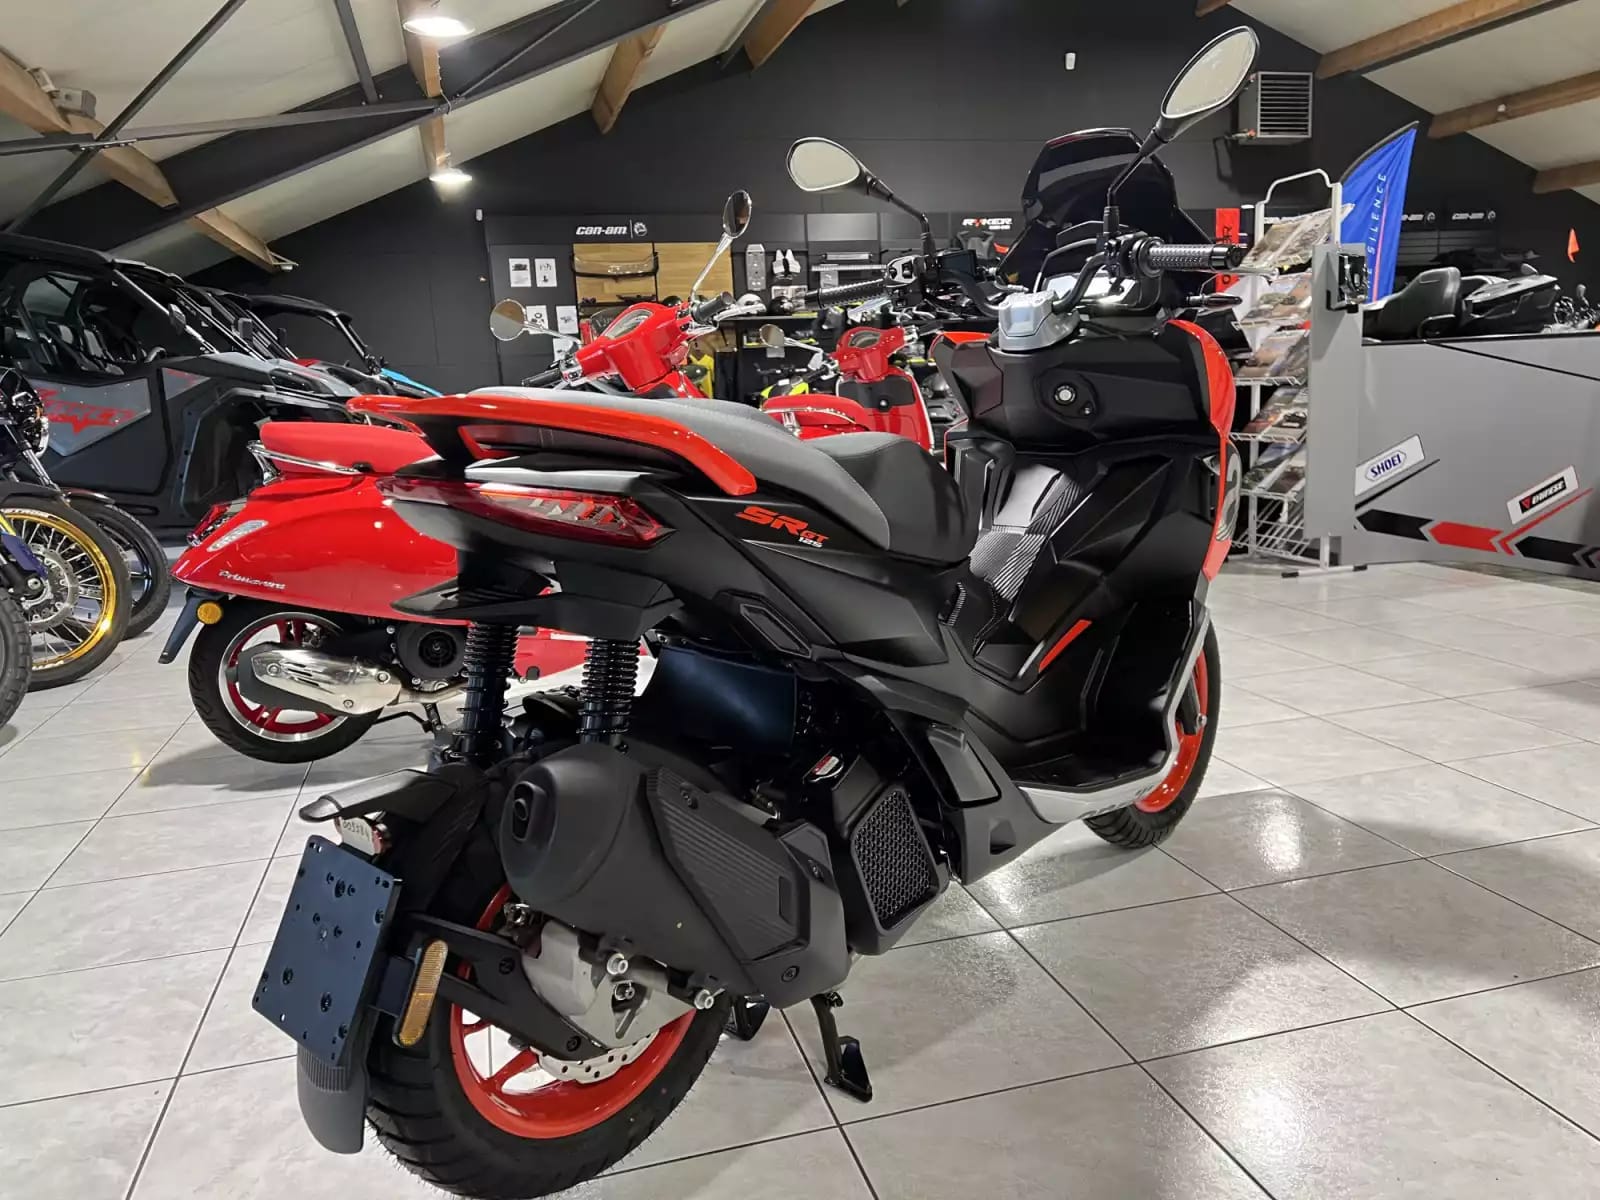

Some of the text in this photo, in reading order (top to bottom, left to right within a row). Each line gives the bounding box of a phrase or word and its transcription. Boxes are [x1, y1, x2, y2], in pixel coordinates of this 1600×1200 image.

[1367, 173, 1387, 255] SILENCE
[575, 226, 628, 236] can-am
[1370, 454, 1402, 478] SHOEI
[735, 505, 829, 543] SR GT
